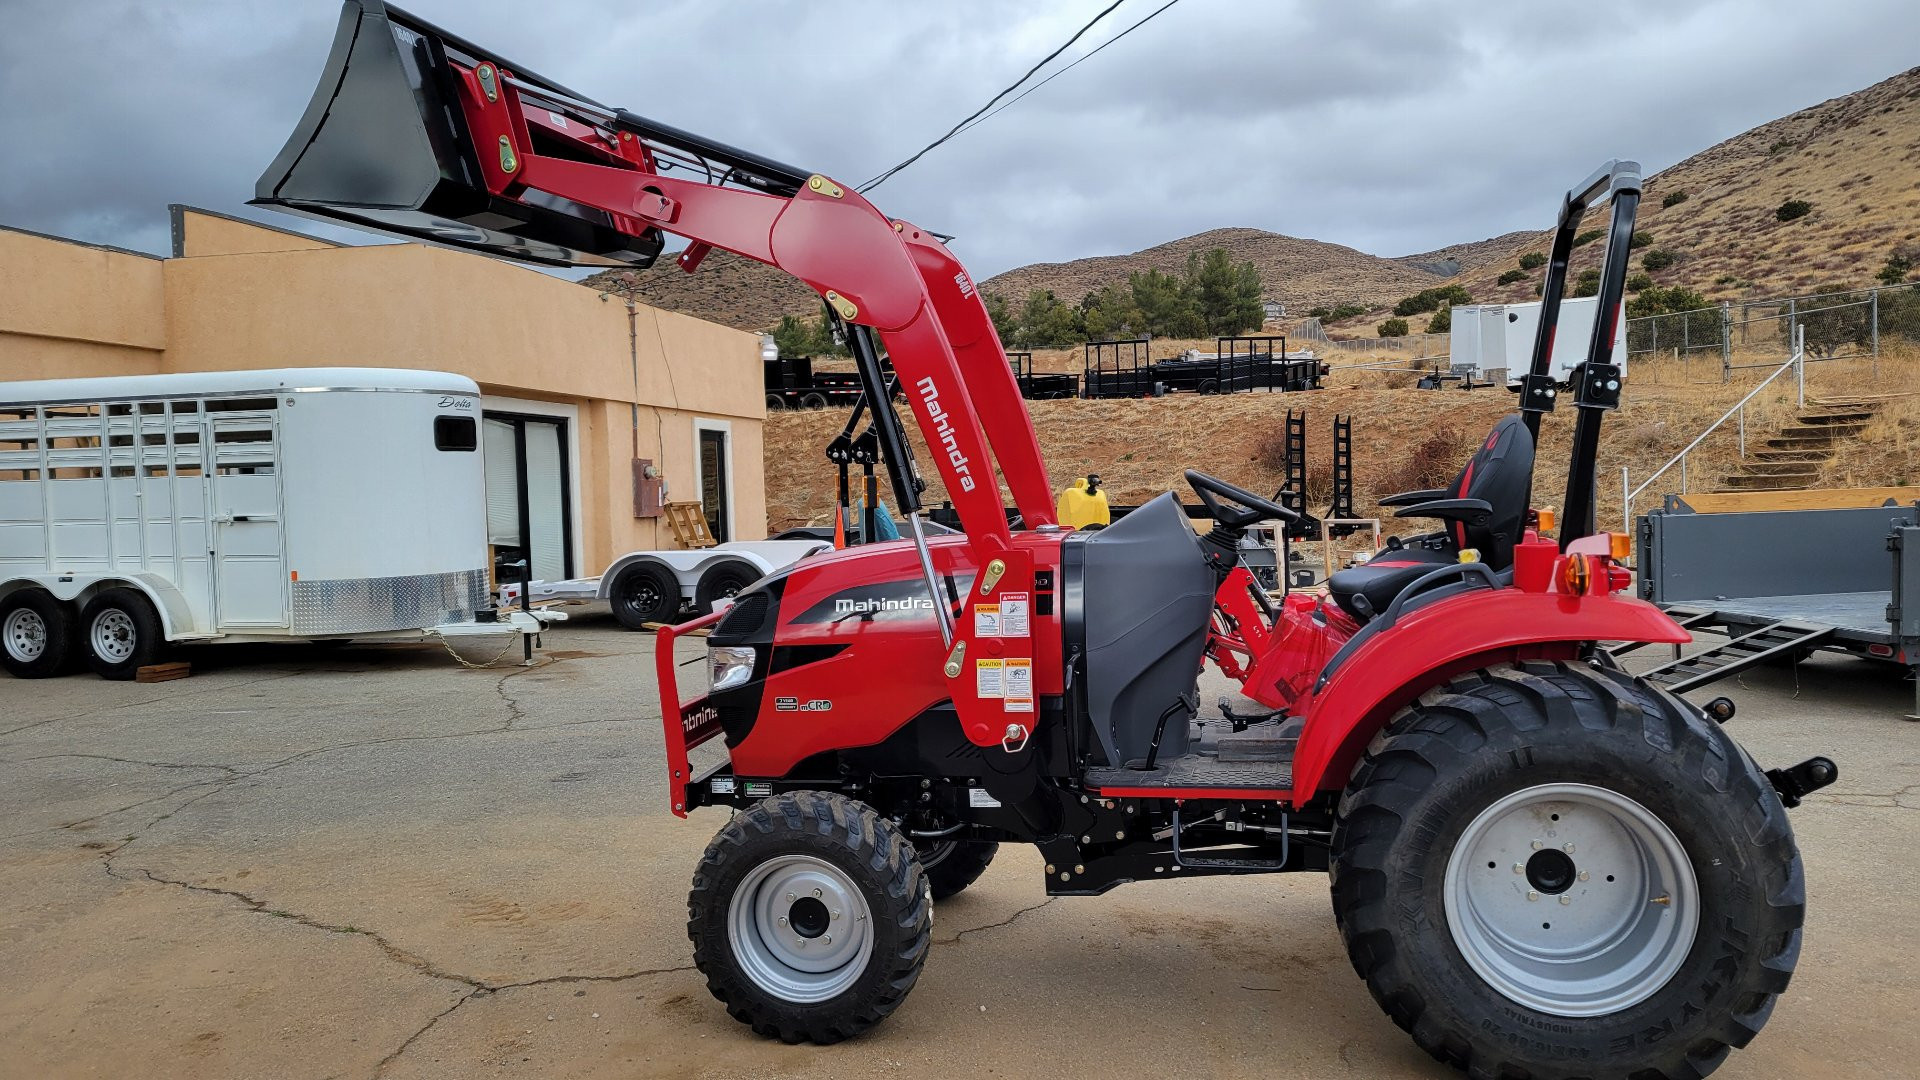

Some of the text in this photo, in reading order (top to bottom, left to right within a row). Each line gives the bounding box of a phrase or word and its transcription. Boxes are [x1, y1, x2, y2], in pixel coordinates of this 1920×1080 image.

[437, 396, 471, 409] Delta
[916, 376, 975, 493] Mahindra
[835, 597, 935, 612] Mahindra
[801, 700, 832, 711] mCRD
[1503, 1007, 1573, 1035] INDUSTRIAL
